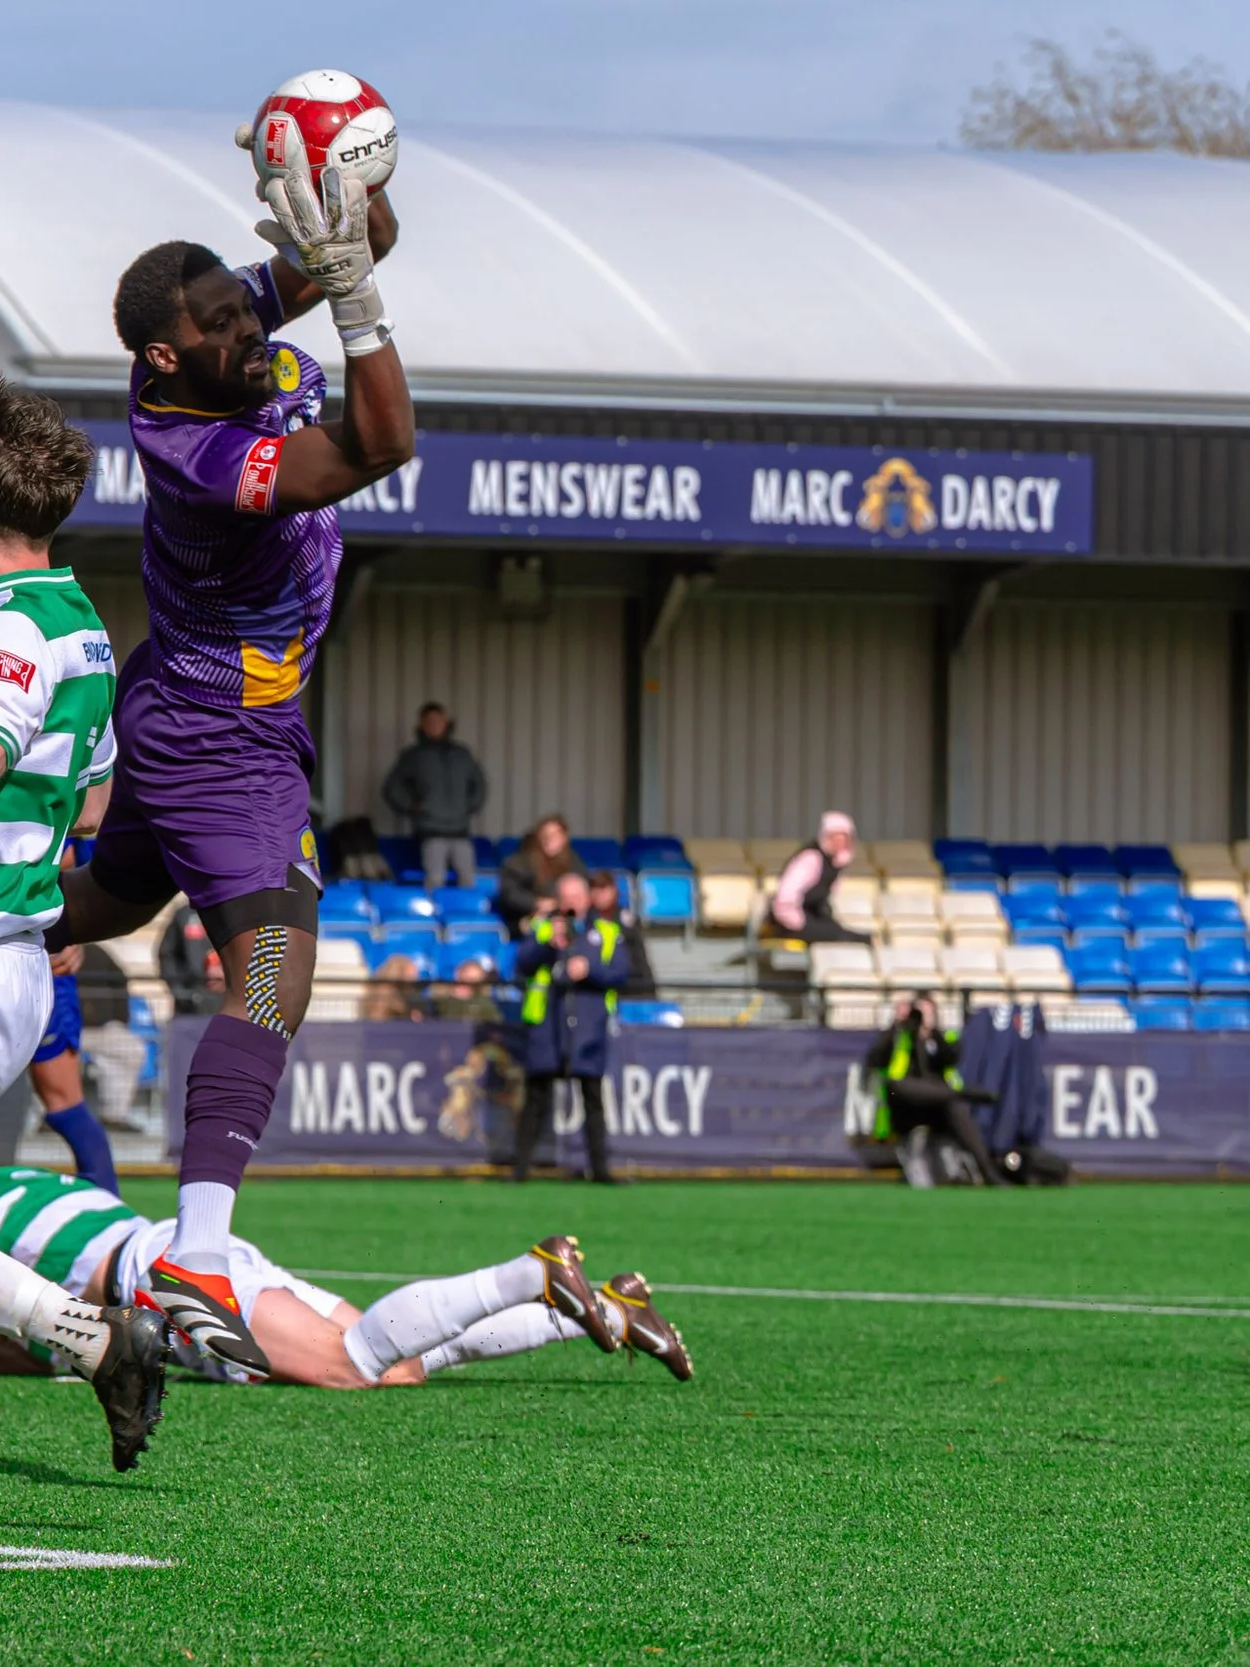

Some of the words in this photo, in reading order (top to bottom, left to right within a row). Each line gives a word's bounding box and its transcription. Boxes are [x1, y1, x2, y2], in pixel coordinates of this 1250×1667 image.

[94, 446, 147, 504] MA
[469, 460, 701, 521] MENSWEAR
[751, 469, 852, 526] MARC
[941, 475, 1062, 533] DARCY
[1, 663, 11, 678] IN
[289, 1061, 428, 1135] MARC
